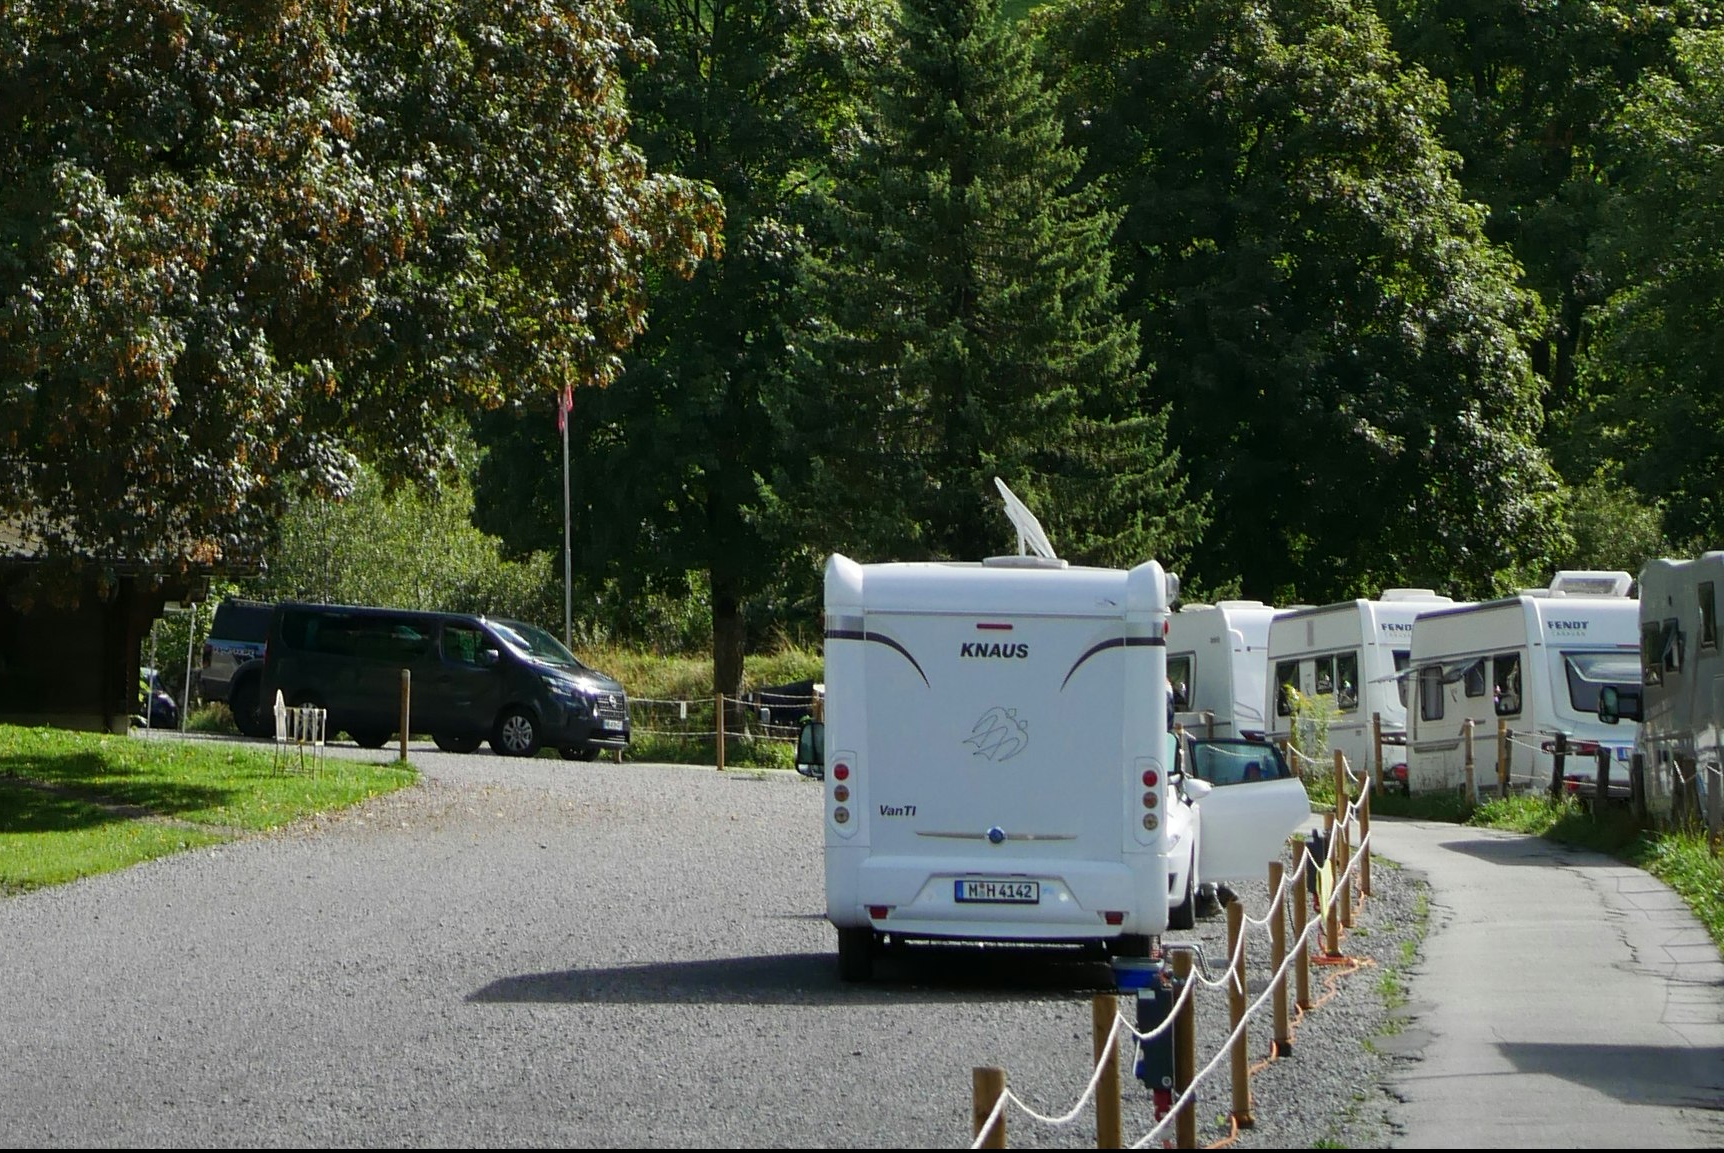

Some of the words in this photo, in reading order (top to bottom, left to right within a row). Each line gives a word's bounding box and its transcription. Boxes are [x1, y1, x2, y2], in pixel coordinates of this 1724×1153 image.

[1380, 623, 1412, 631] FEND
[1547, 620, 1589, 629] FENDT
[960, 642, 1029, 659] KNAUS
[999, 884, 1032, 898] 4142
